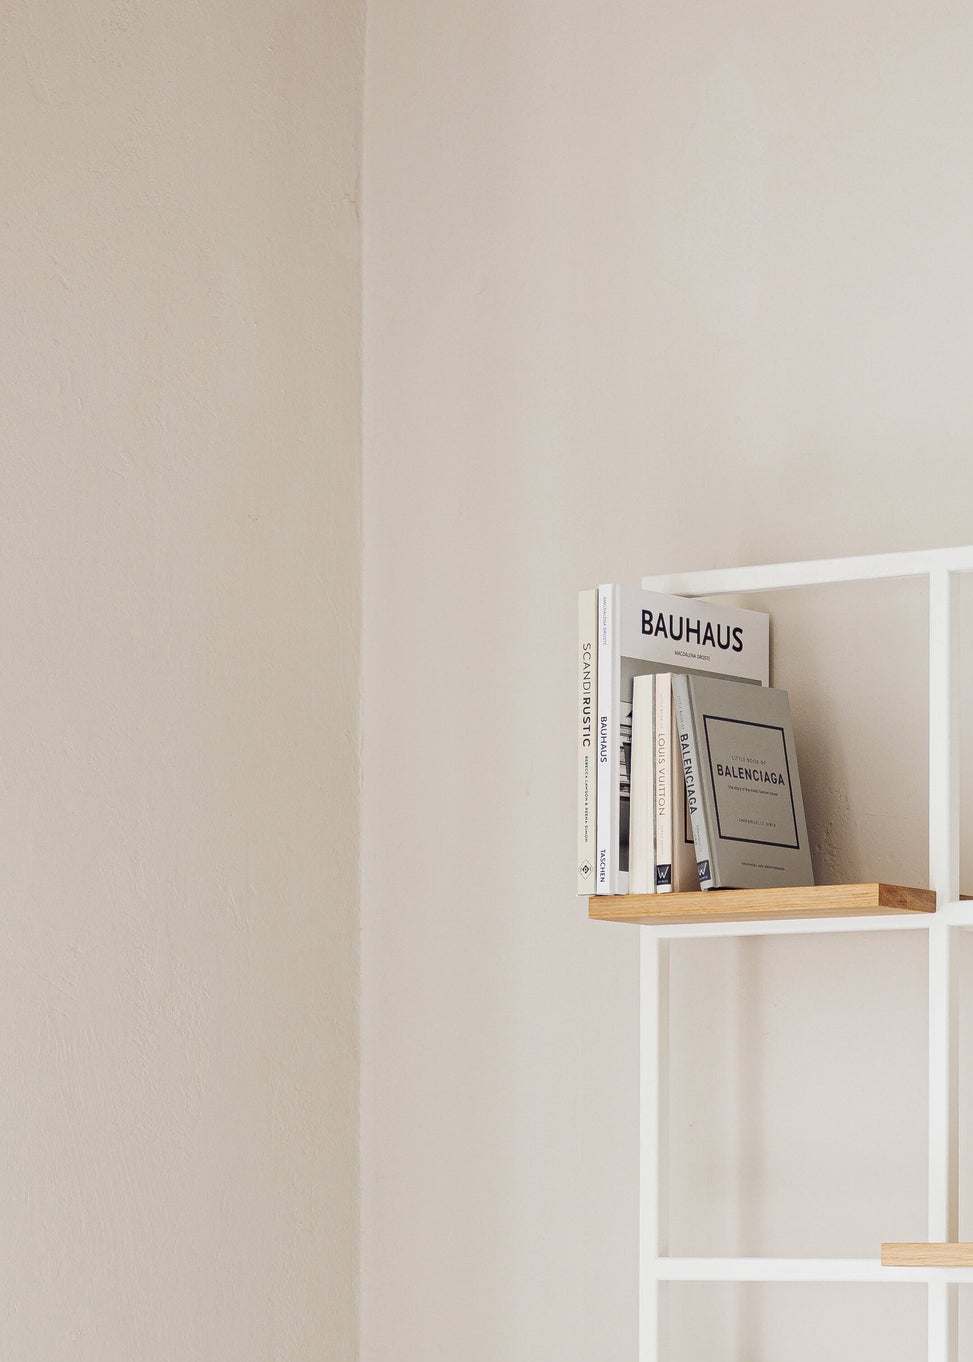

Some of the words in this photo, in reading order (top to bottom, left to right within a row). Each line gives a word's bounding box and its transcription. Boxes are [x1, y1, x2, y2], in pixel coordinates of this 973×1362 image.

[641, 609, 743, 652] BAUHAUS
[600, 716, 608, 763] BAUHAUS
[658, 733, 666, 764] LOUIS
[658, 767, 666, 816] VUITTON
[680, 733, 698, 815] BALENCIAGA
[716, 764, 785, 786] BALENCIAGA
